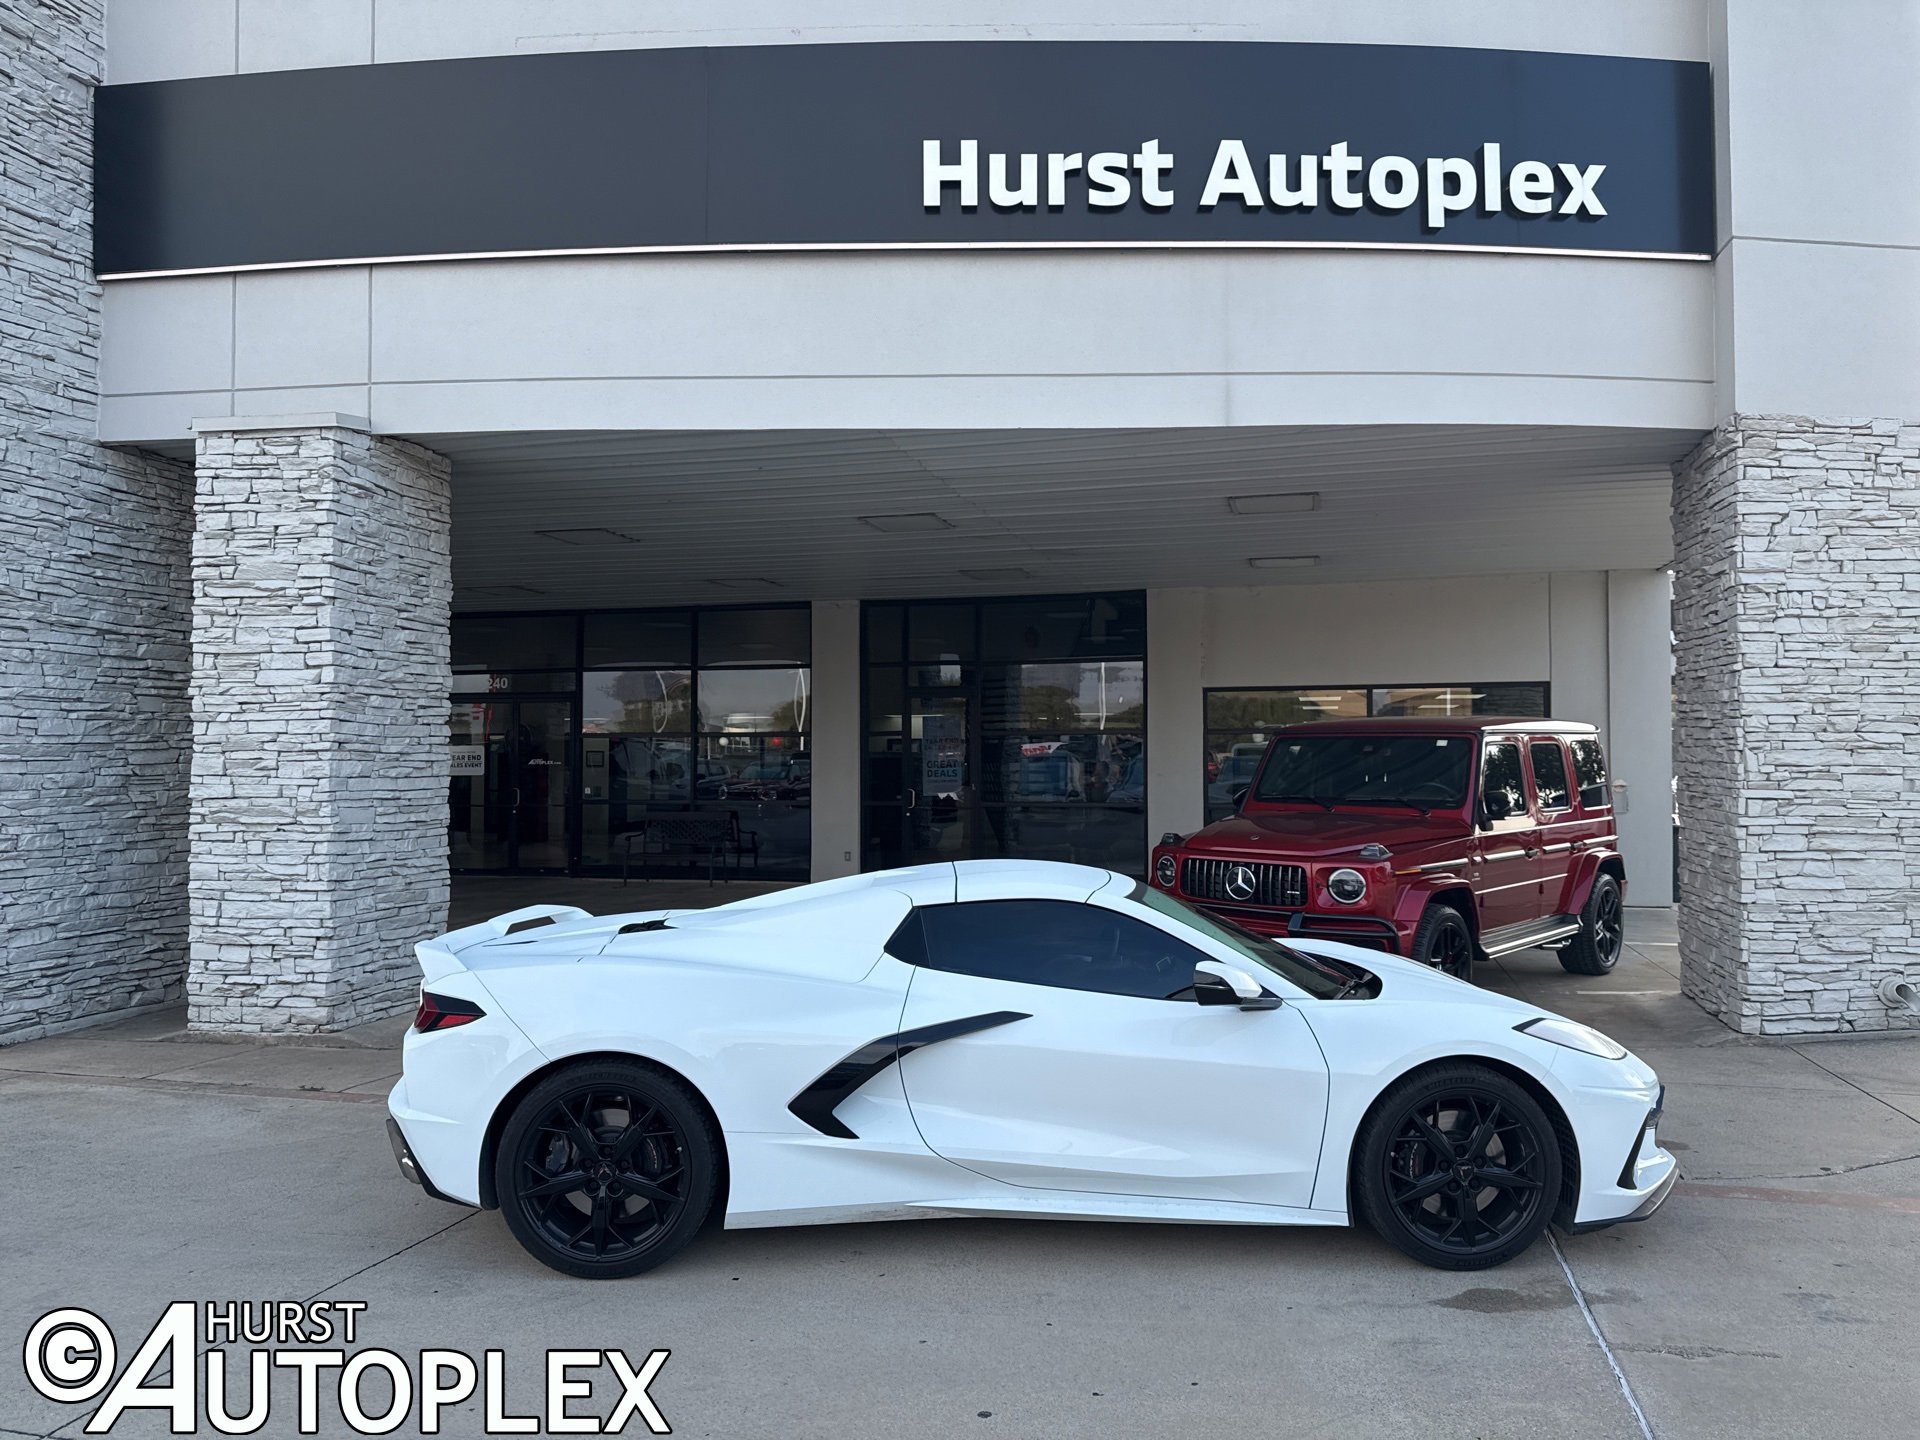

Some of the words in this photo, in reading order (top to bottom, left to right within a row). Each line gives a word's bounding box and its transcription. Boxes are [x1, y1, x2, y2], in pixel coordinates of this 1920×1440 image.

[922, 138, 1174, 207] Hurst
[1200, 139, 1608, 229] Autoplex
[926, 760, 958, 769] GREAT
[927, 769, 958, 778] DEALS
